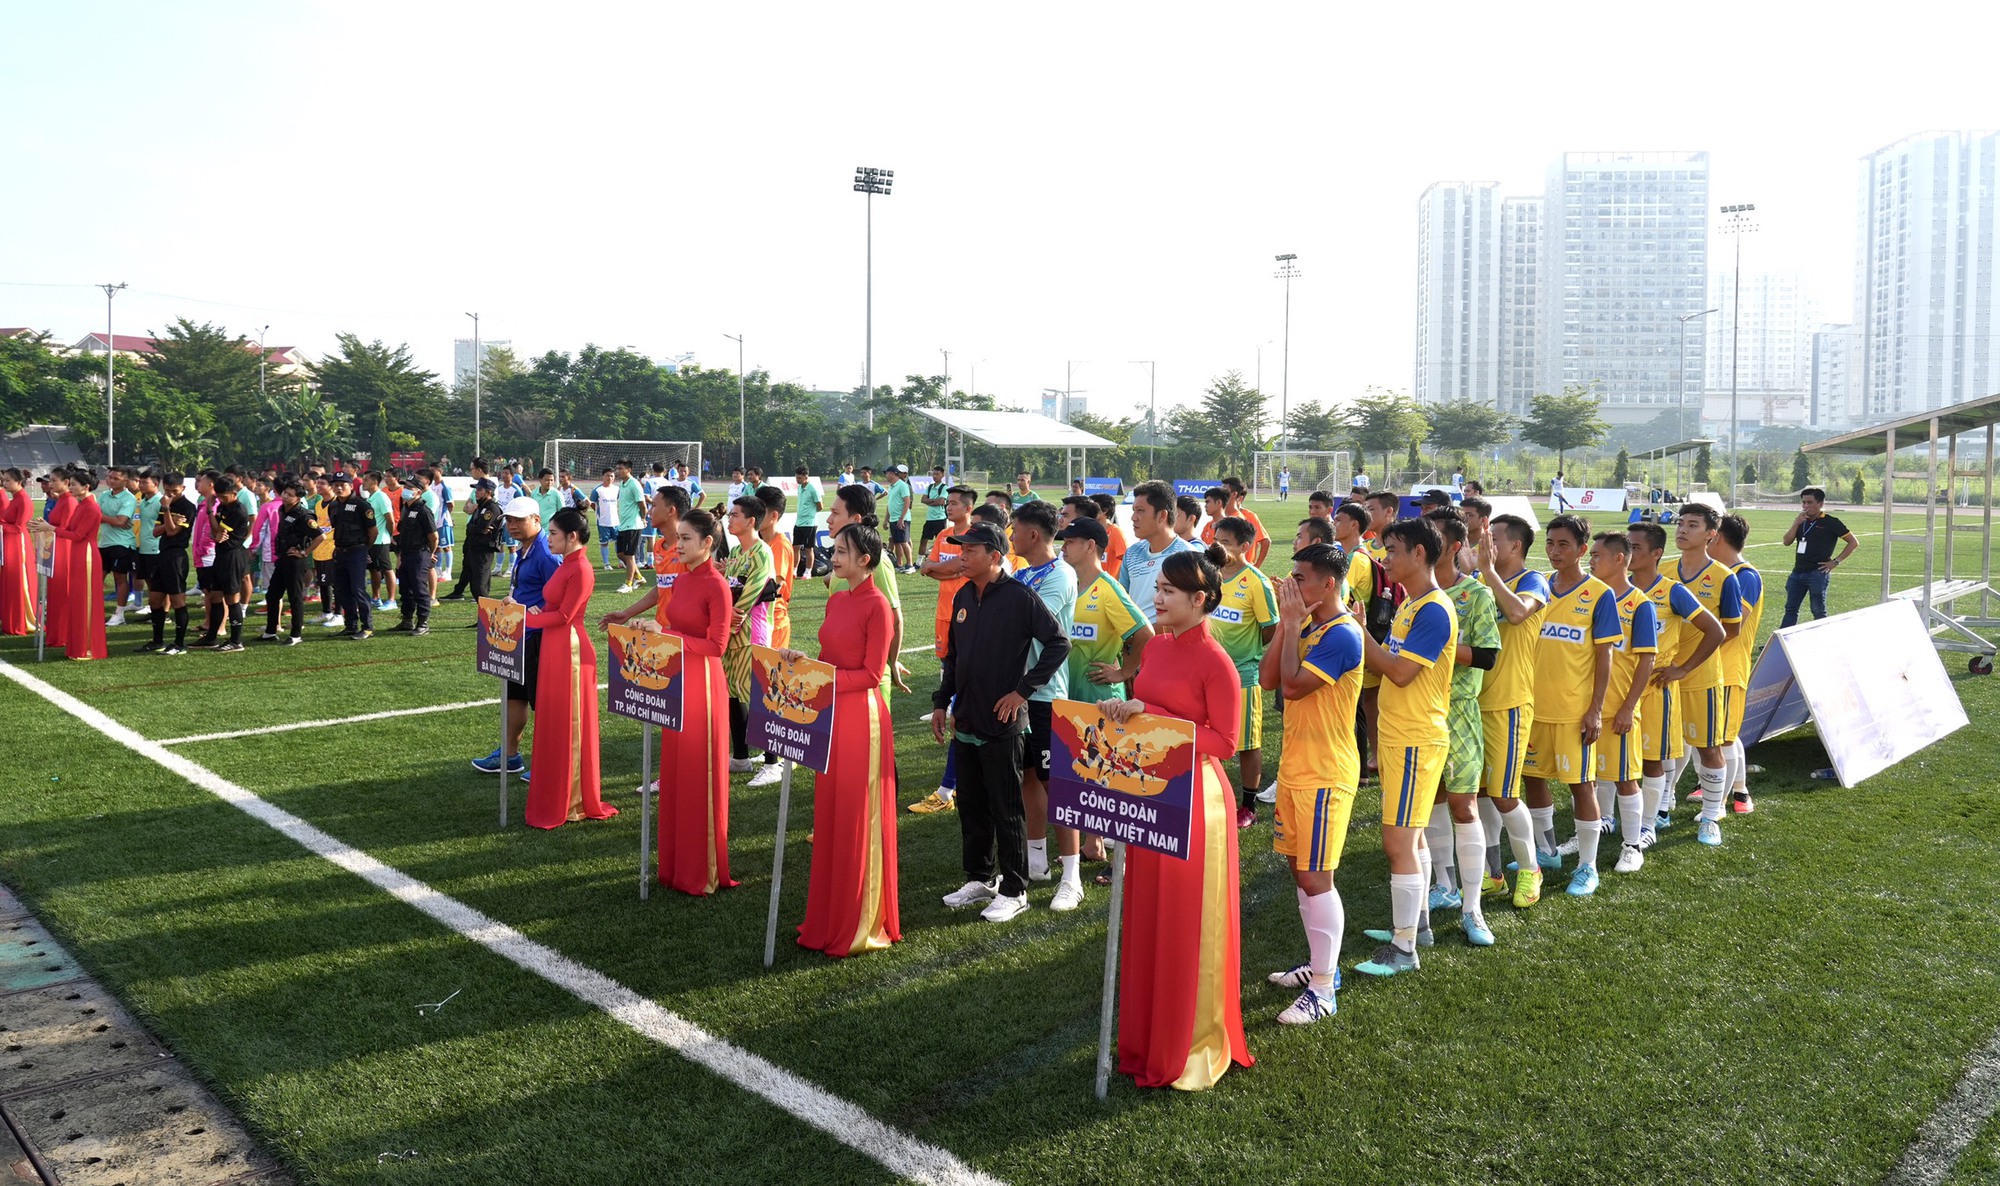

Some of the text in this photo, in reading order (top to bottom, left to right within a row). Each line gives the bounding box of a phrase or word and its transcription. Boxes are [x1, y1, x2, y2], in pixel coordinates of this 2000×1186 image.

[345, 504, 357, 512] SWAT
[1211, 607, 1240, 621] ACO
[1071, 624, 1094, 637] ACO
[1540, 624, 1581, 640] HACO
[624, 687, 666, 709] CÔNG ĐOÀN
[615, 700, 625, 712] TP.
[637, 707, 650, 720] CHÍ
[651, 710, 670, 726] MINH
[765, 720, 811, 746] CÔNG ĐOÀN
[767, 738, 804, 762] TÂY NINH
[1555, 754, 1570, 772] 14
[1079, 790, 1157, 824] CÔNG ĐOÀN
[1055, 805, 1179, 853] DỆT MAY VIỆT NAM
